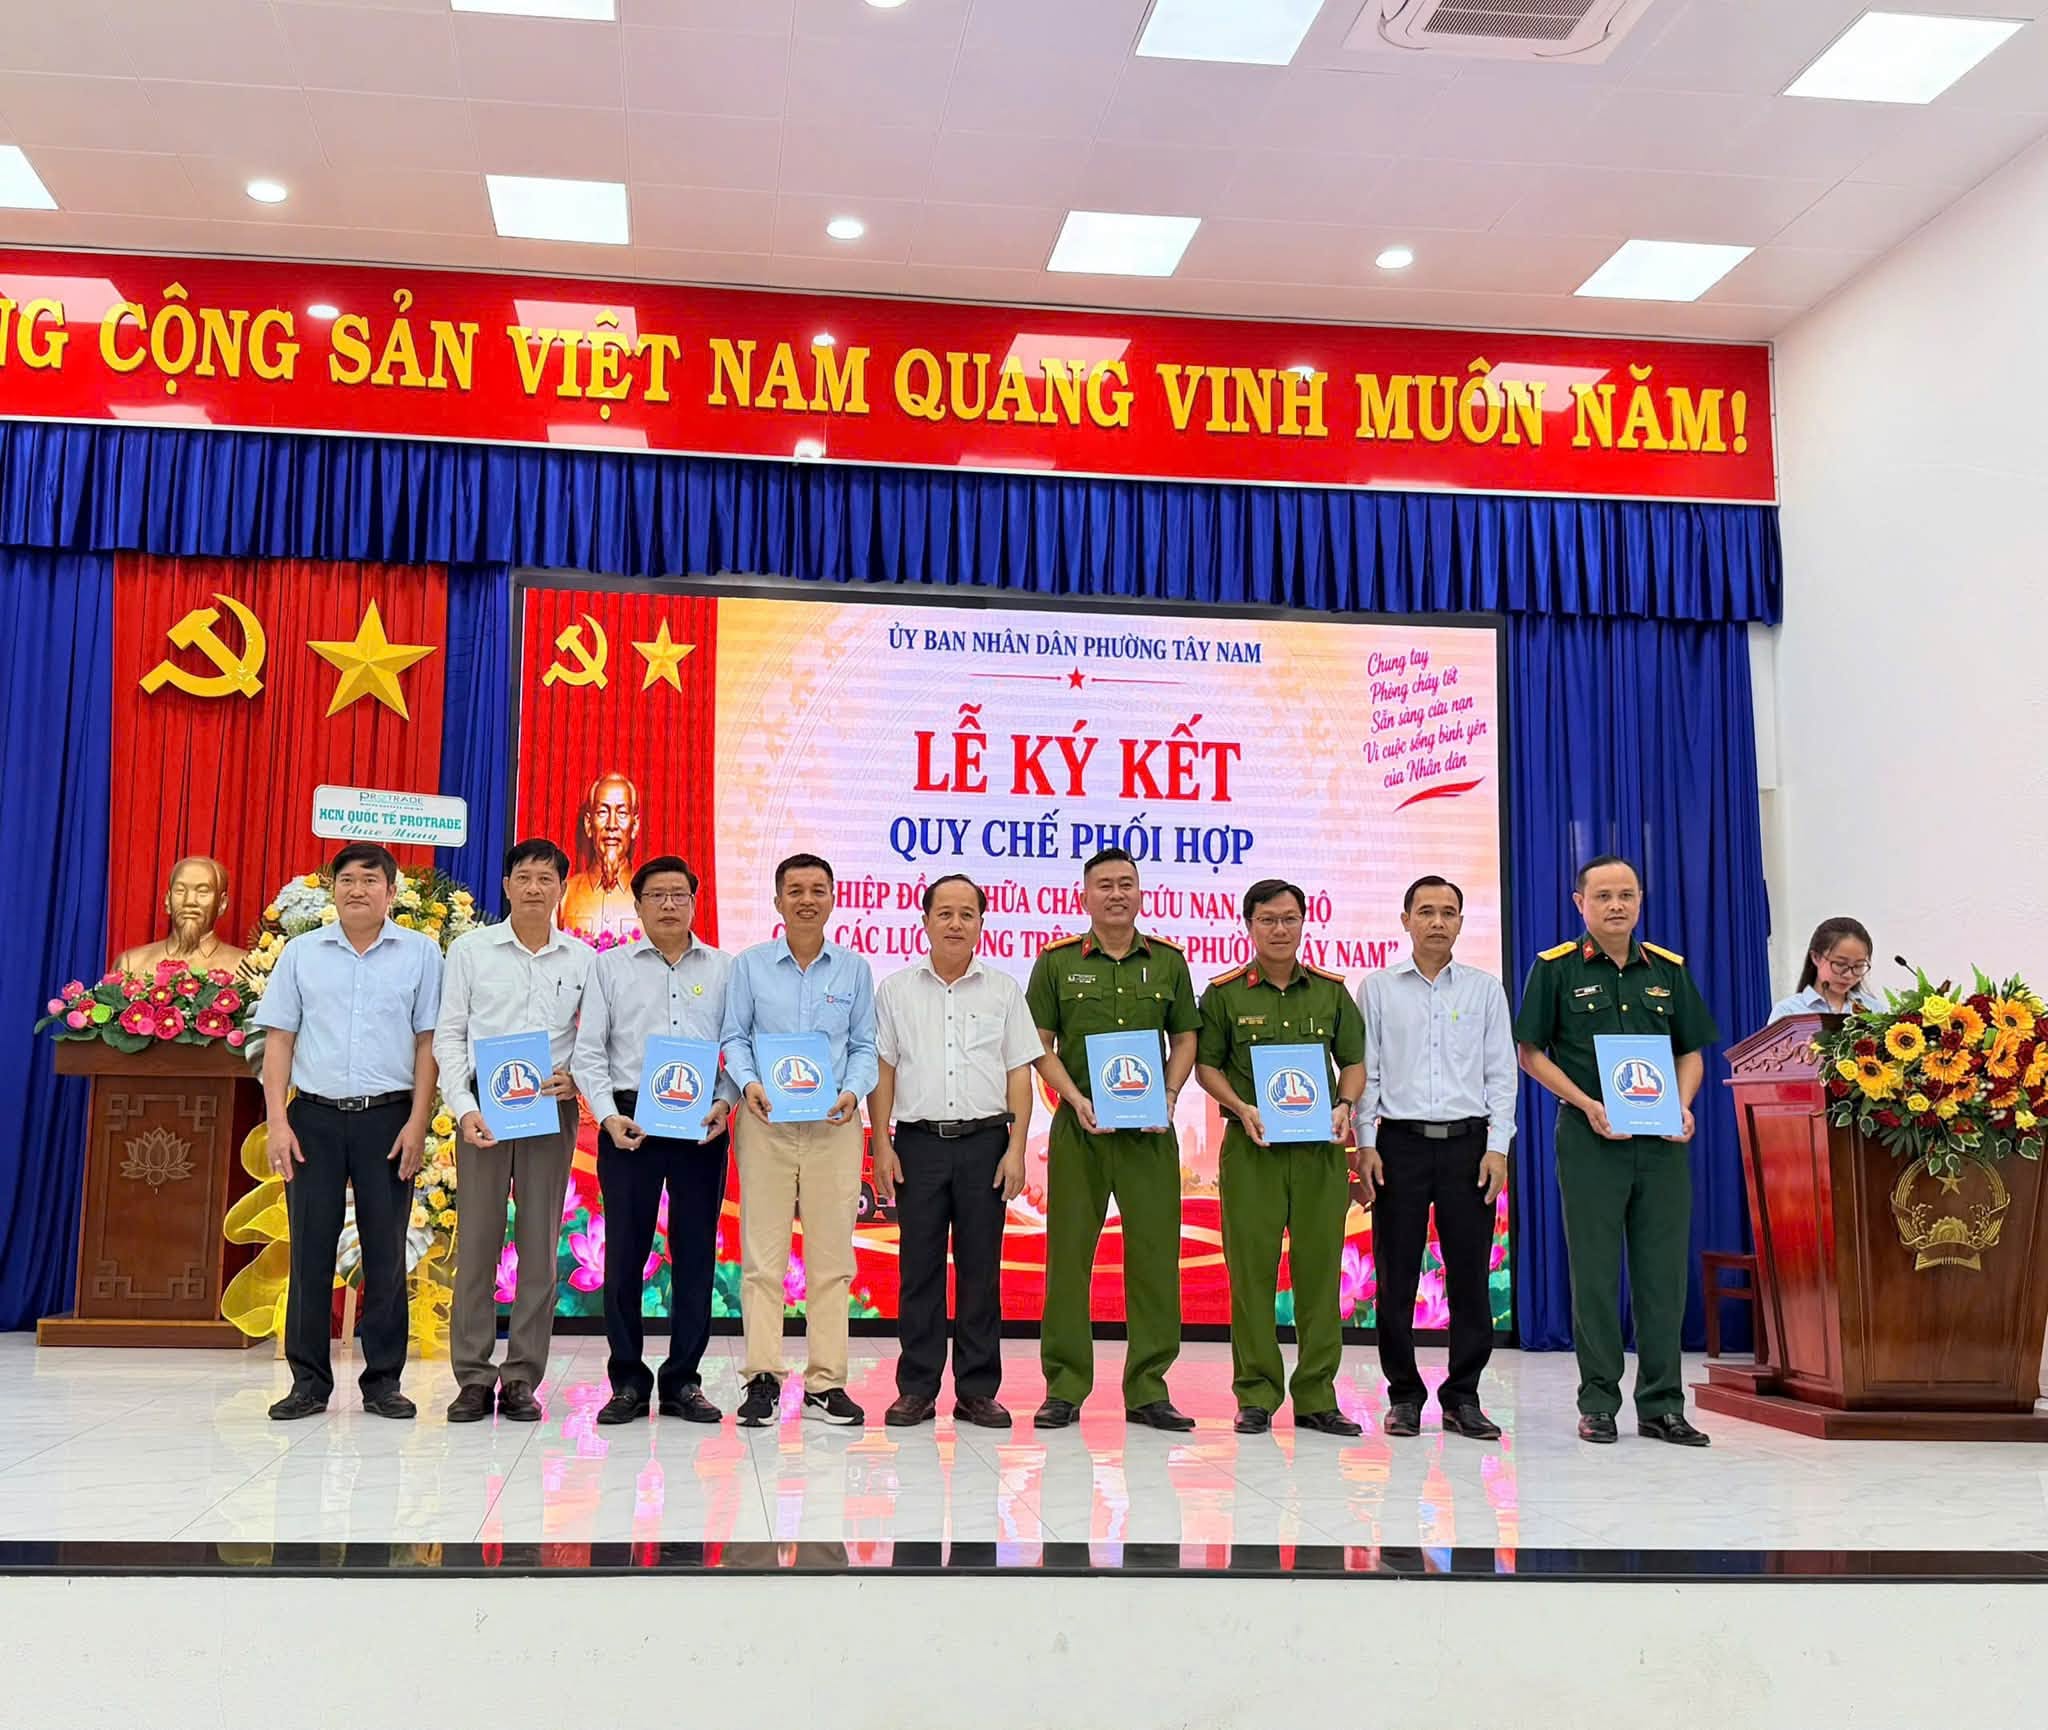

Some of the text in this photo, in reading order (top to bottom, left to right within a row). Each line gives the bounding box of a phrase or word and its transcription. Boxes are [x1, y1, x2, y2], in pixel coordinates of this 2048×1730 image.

[99, 281, 300, 395] CỘNG
[328, 288, 480, 390] SẢN
[506, 308, 682, 420] VIỆT
[707, 337, 871, 414] NAM
[894, 348, 1134, 428] QUANG
[1156, 363, 1329, 437] VINH
[1355, 356, 1547, 446] MUÔN
[1571, 363, 1748, 454] NĂM!
[889, 622, 1262, 663] ỦY BAN NHÂN DÂN PHƯỜNG TÂY NAM
[1367, 648, 1429, 677] Chung tay
[1370, 666, 1458, 704] Phòng cháy tốt
[1371, 696, 1473, 734] Sẵn sàng cứu nạn
[913, 703, 1242, 802] LỄ KÝ KẾT
[1382, 737, 1407, 759] cuộc
[1409, 729, 1436, 754] sống
[1467, 719, 1487, 745] yên
[1407, 757, 1441, 782] Nhân
[1445, 750, 1467, 771] dân
[347, 807, 378, 824] QUỐC
[382, 808, 397, 825] TẾ
[400, 814, 462, 830] PROTRADE
[890, 809, 1254, 873] QUY CHẾ PHỐI HỢP
[836, 874, 890, 915] HIỆP
[896, 872, 929, 911] ĐỒ
[978, 879, 1031, 914] HỮA
[1037, 881, 1090, 915] CHÁ
[1139, 883, 1183, 918] CỨU
[1189, 892, 1242, 926] NẠN,
[835, 918, 880, 954] CÁC
[886, 924, 929, 962] LỰC
[1187, 930, 1254, 965] PHƯỜ
[1300, 932, 1330, 967] ÂY
[1336, 940, 1399, 969] NAM”
